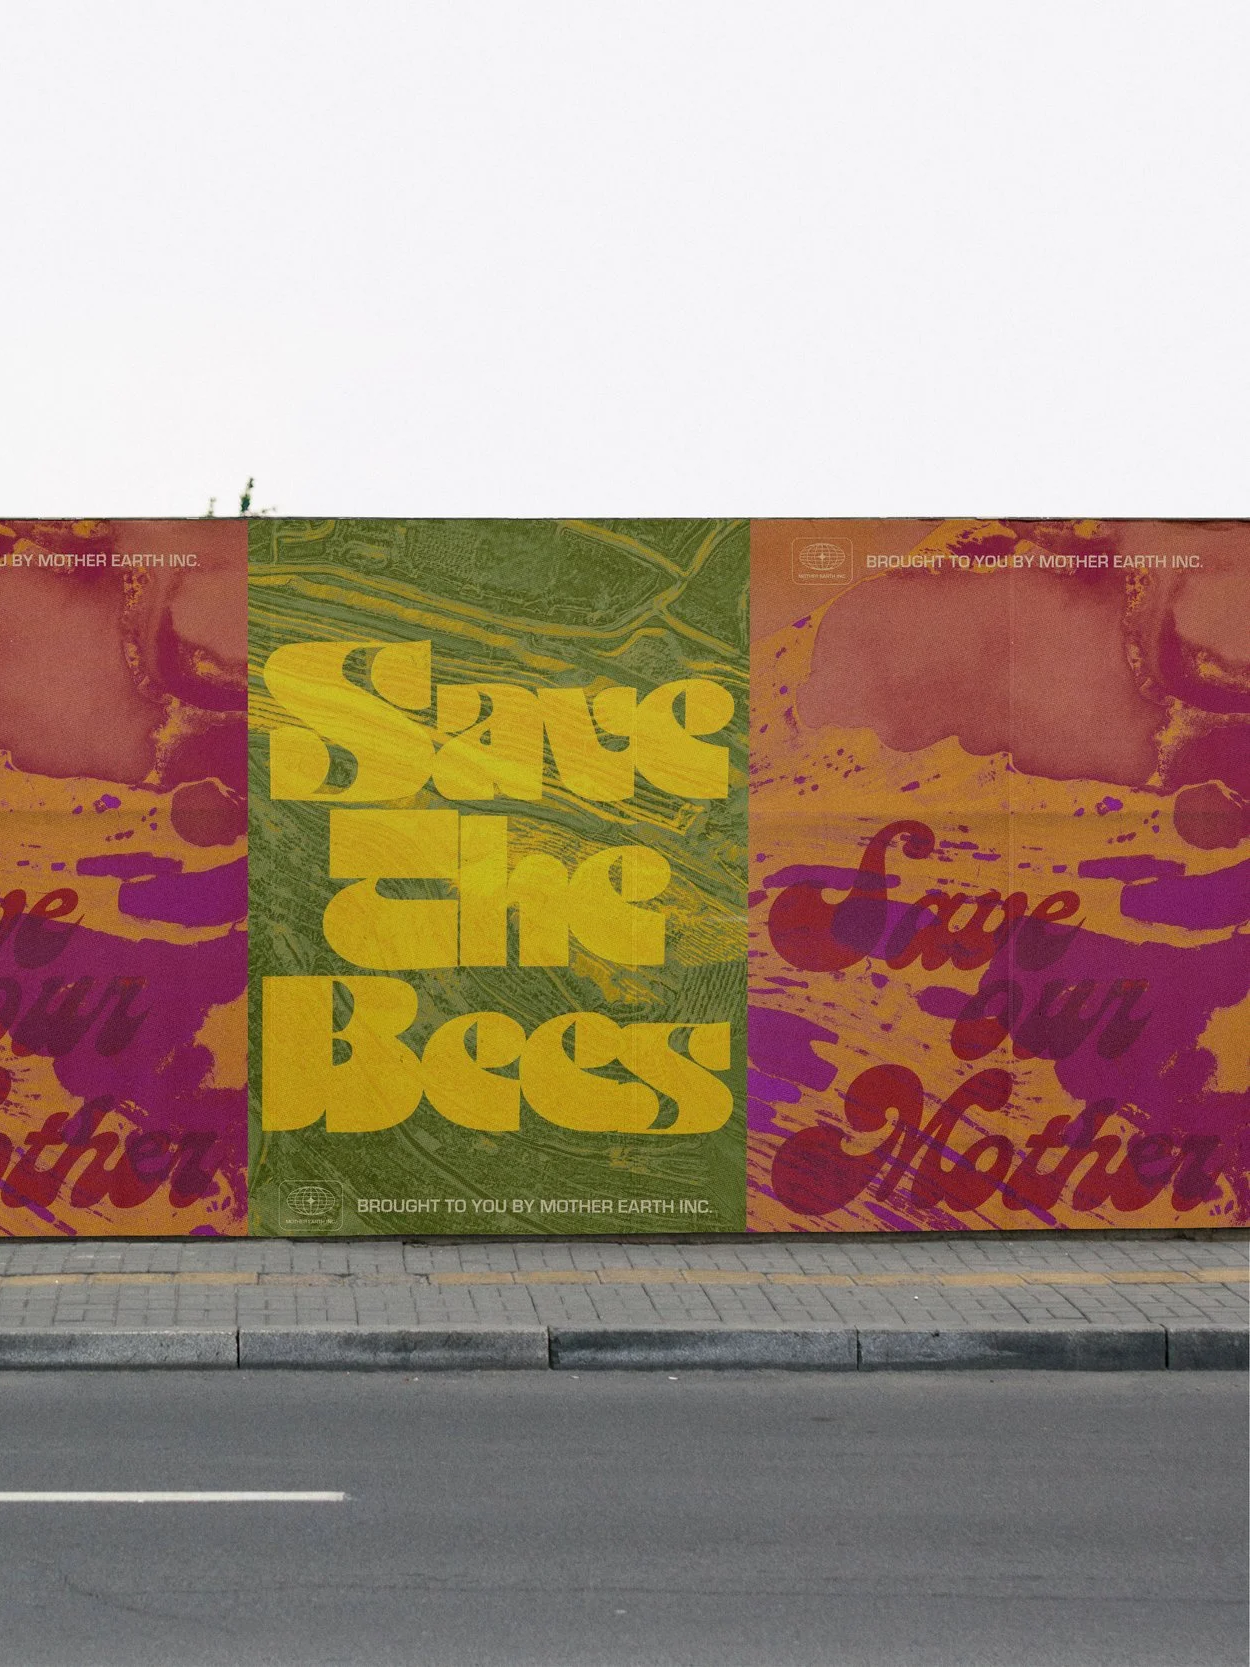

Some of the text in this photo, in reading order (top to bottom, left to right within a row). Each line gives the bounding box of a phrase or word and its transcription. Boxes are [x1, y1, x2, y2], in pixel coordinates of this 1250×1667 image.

[12, 554, 33, 567] BY
[38, 554, 106, 567] MOTHER
[111, 554, 164, 567] EARTH
[169, 554, 200, 567] INC.
[866, 555, 1203, 568] BROUGHT TO YOU BY MOTHER EARTH INC.
[263, 640, 735, 800] Save
[768, 820, 1086, 972] Save
[262, 976, 734, 1134] Bees
[950, 978, 1151, 1061] our
[772, 1063, 1224, 1216] Mother
[357, 1199, 713, 1213] BROUGHT TO YOU BY MOTHER EARTH INC.
